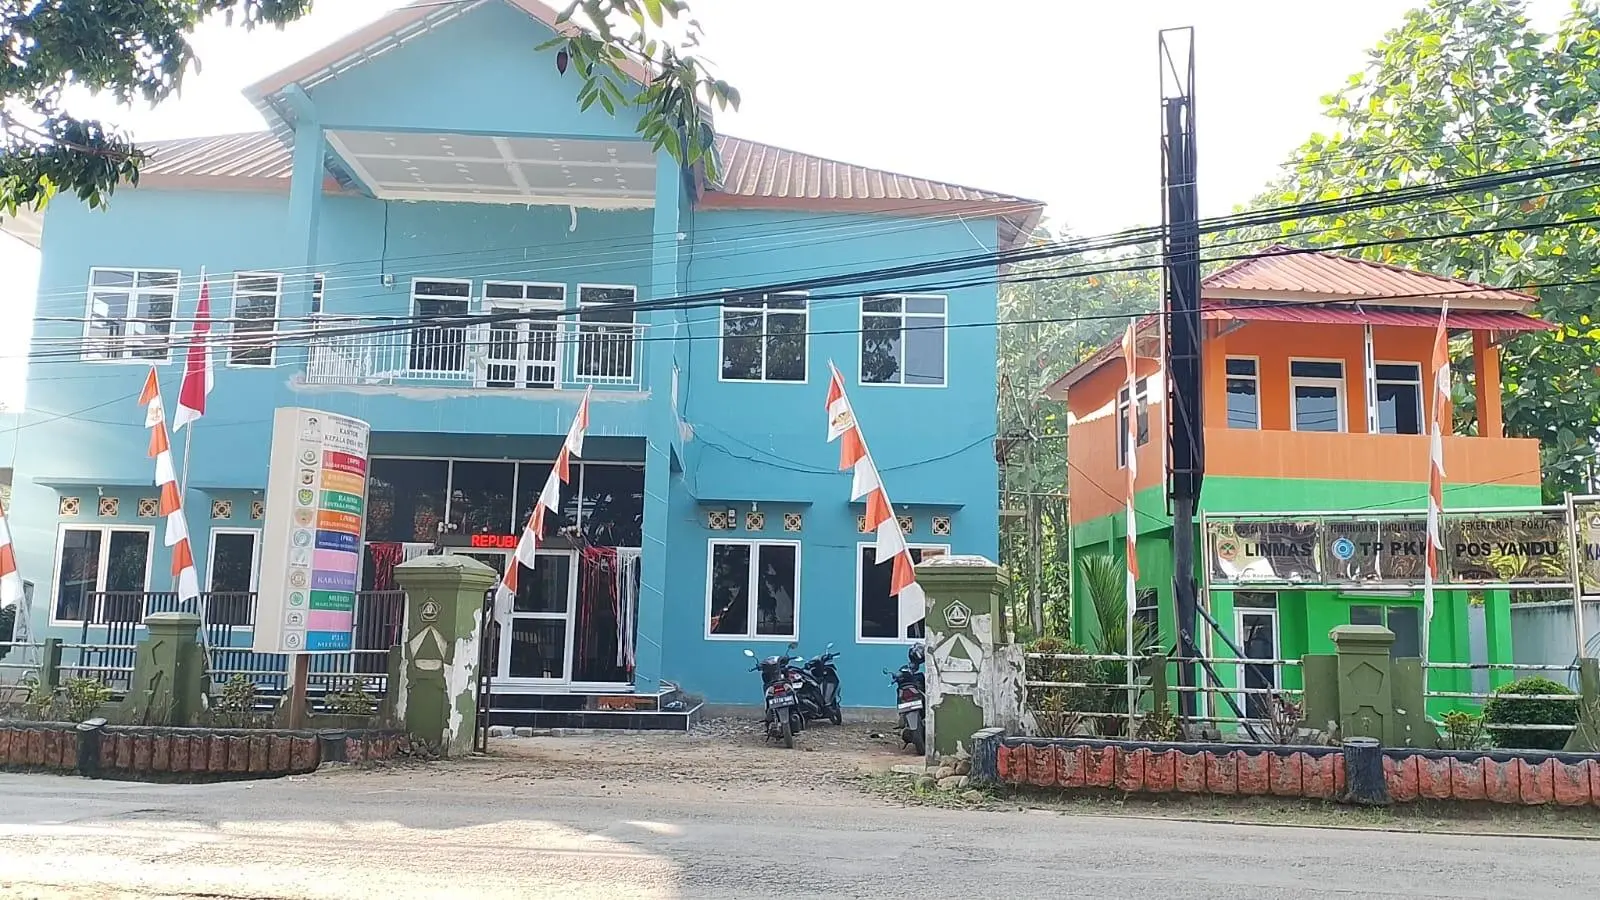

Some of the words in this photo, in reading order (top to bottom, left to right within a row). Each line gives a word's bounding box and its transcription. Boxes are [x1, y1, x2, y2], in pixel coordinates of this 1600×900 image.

[324, 434, 346, 445] KEPALA
[1460, 520, 1513, 530] SEKERTARIAT
[1521, 520, 1550, 530] POKJA
[1245, 543, 1312, 557] LINMAS
[1360, 542, 1384, 556] TP
[1456, 542, 1492, 557] POS
[1497, 541, 1559, 556] YANDU
